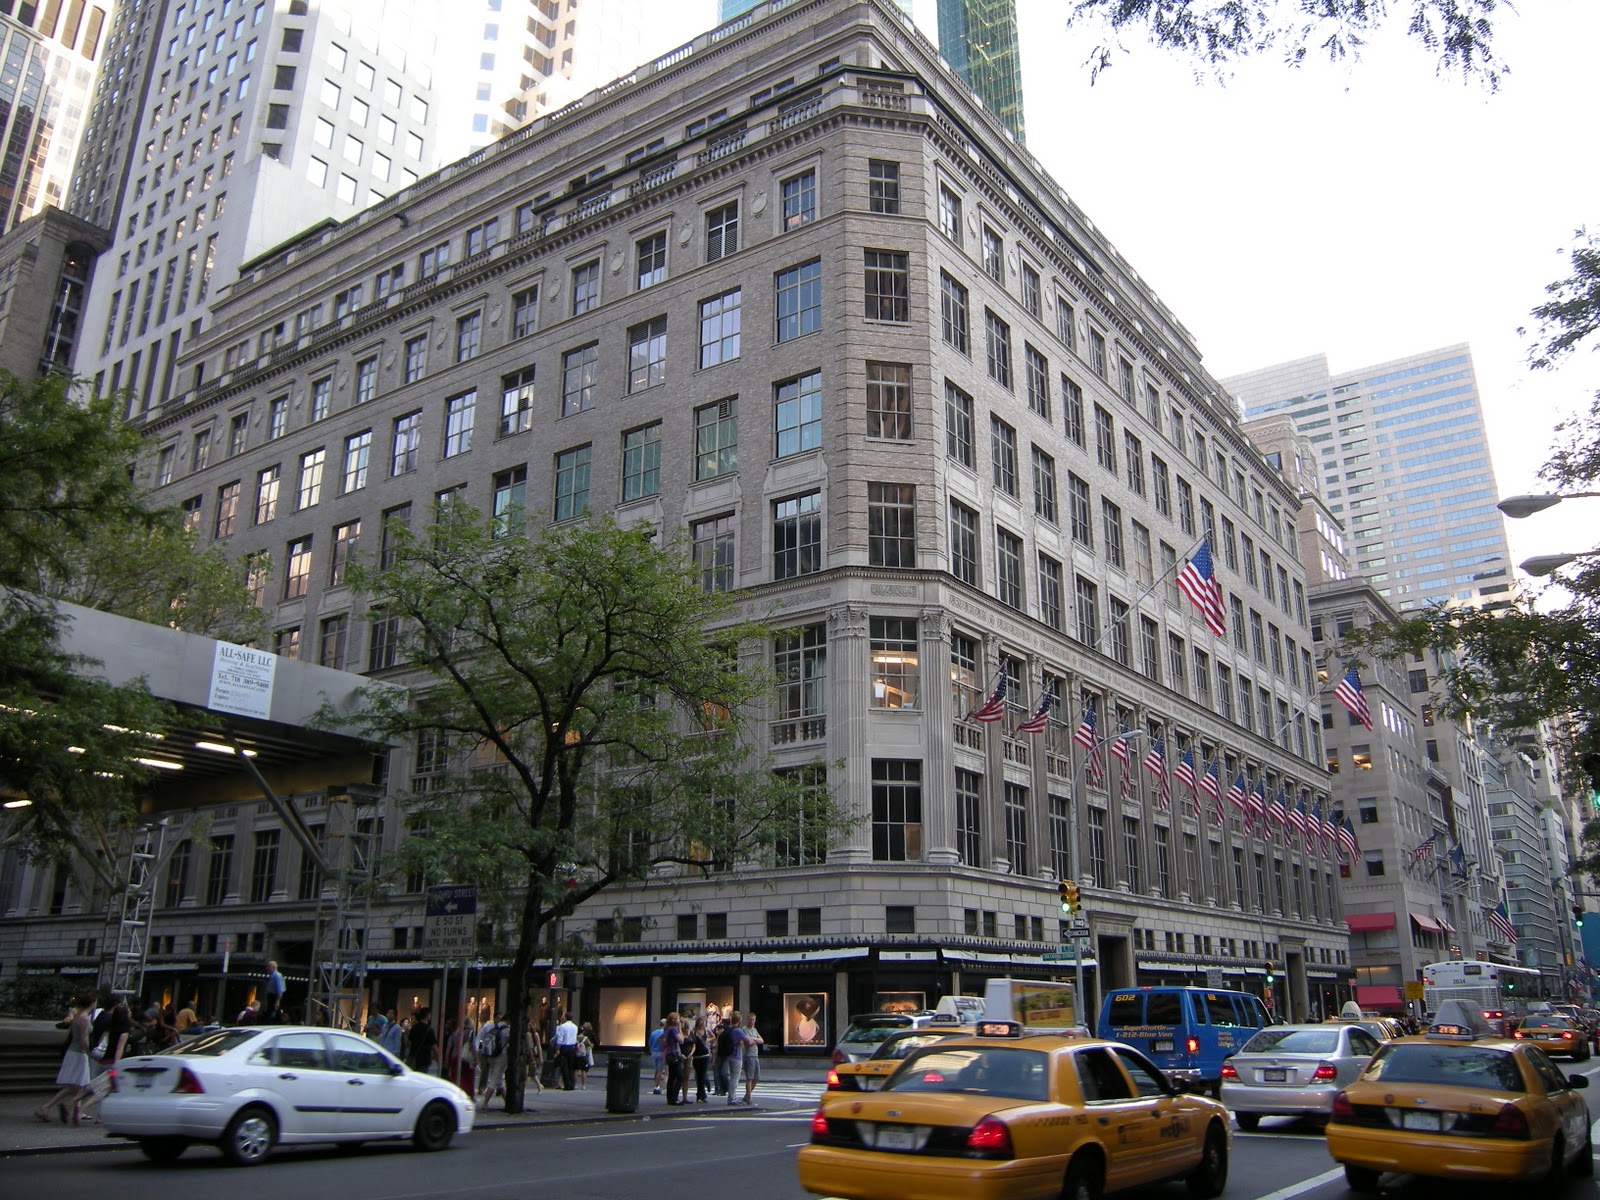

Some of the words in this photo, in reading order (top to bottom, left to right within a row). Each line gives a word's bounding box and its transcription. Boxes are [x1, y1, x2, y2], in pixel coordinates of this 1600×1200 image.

[220, 647, 255, 663] ALL-SAFE
[258, 656, 272, 667] LLC
[454, 889, 476, 898] STREET
[436, 917, 440, 925] E
[444, 917, 453, 925] 50
[455, 916, 464, 924] ST
[431, 928, 440, 936] NO
[444, 927, 467, 936] TURNS
[443, 938, 458, 946] PARK
[461, 938, 472, 946] AVE
